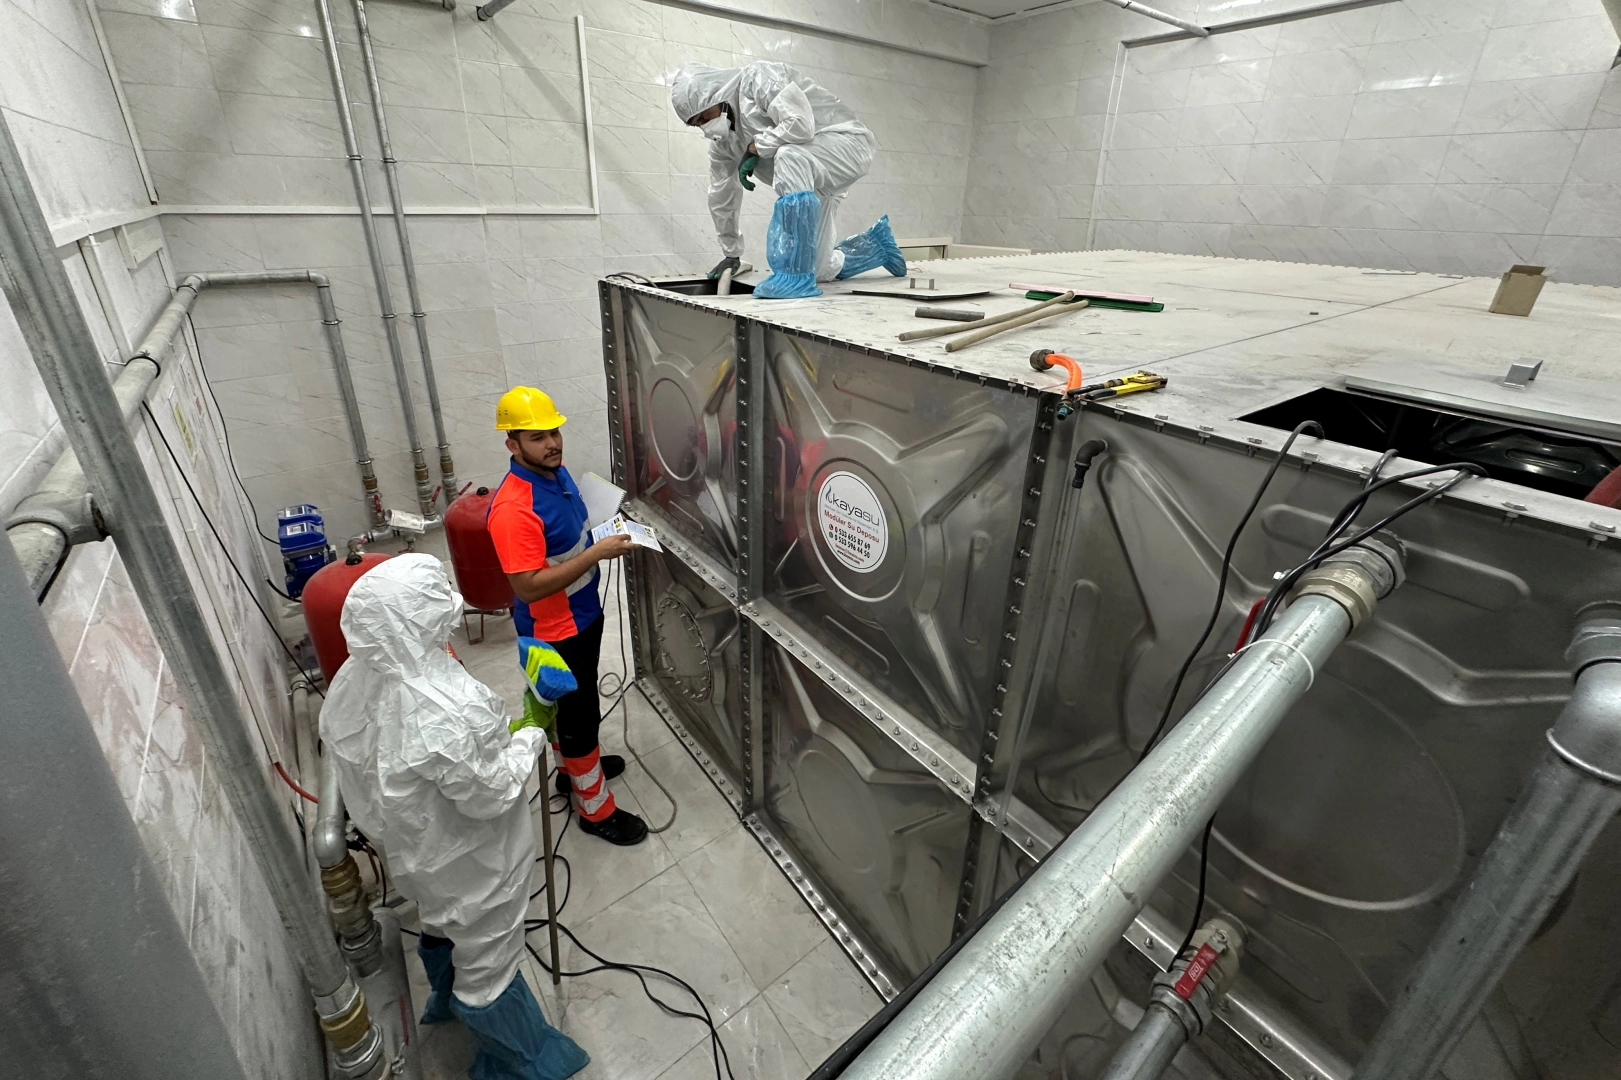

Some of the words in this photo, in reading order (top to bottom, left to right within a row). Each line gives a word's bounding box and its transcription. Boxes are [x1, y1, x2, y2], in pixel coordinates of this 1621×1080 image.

[832, 493, 879, 526] kayasu
[847, 521, 855, 531] Su
[857, 526, 880, 543] Deposu
[848, 533, 857, 543] 655
[847, 541, 857, 551] 596
